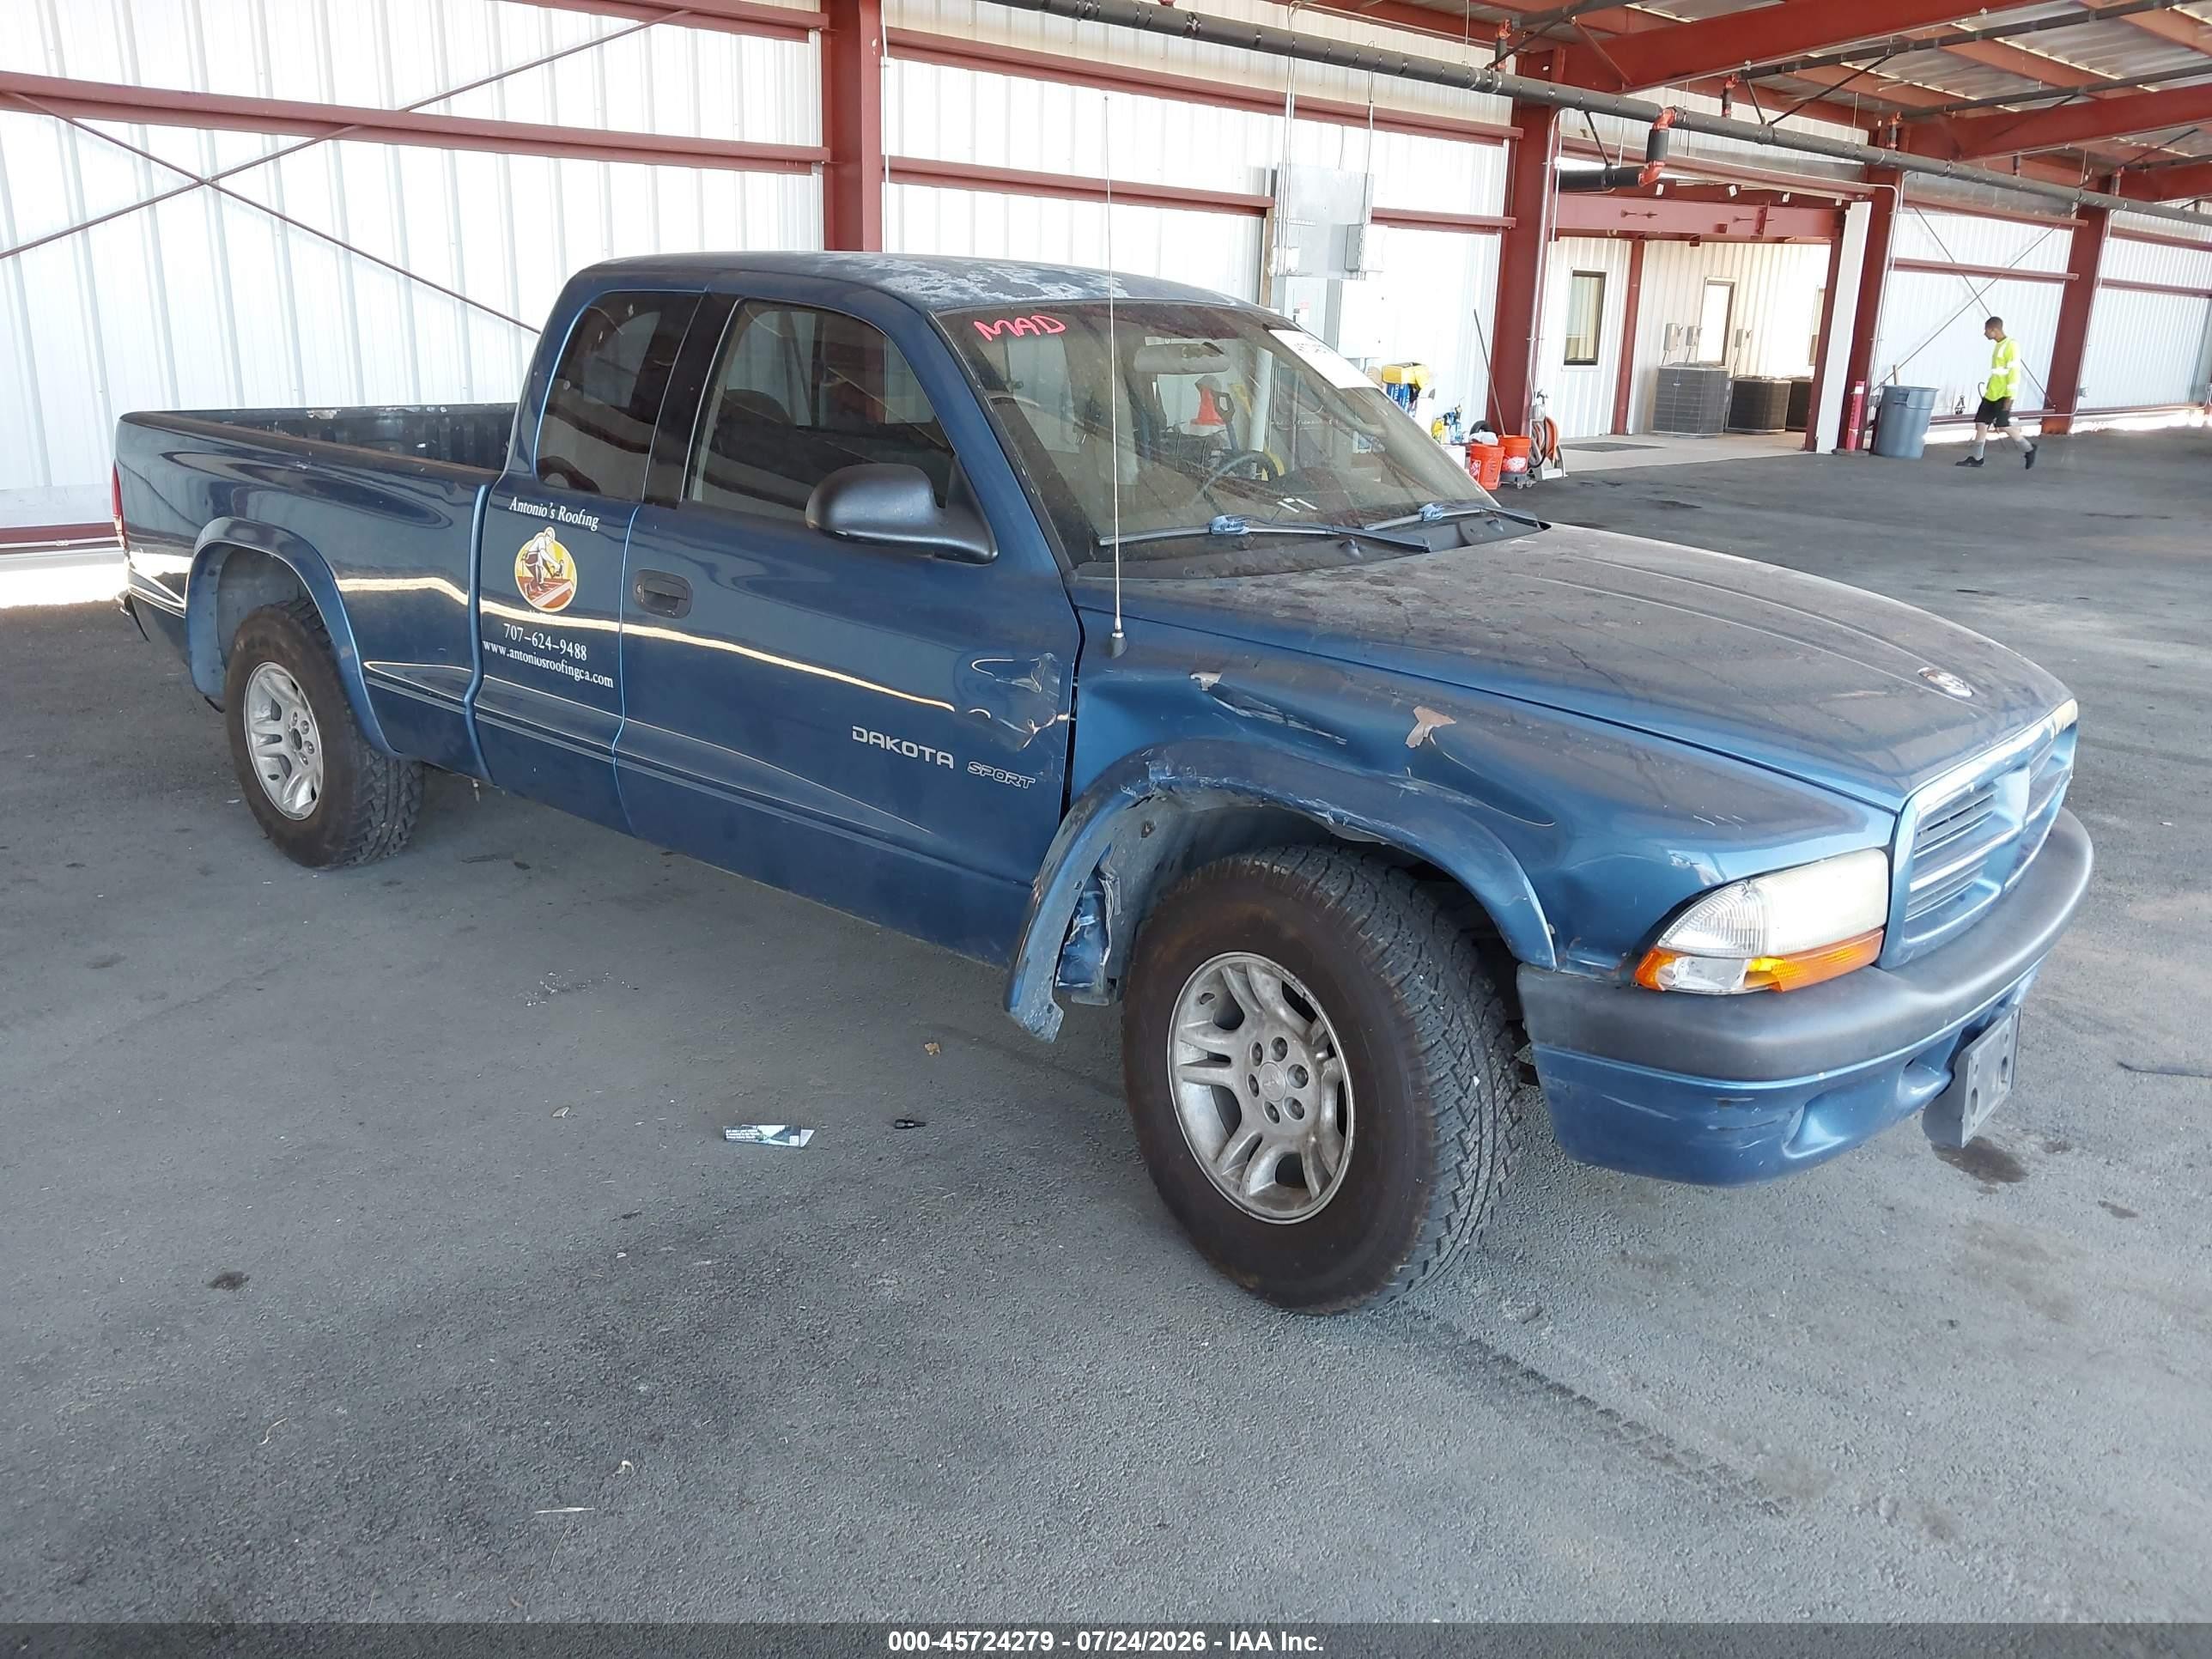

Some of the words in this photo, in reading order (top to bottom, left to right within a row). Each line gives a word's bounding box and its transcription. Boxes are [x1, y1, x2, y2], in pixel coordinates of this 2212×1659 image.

[973, 314, 1066, 342] MAD
[508, 495, 556, 520] Antonio's
[557, 505, 600, 532] Roofing
[503, 623, 588, 661] 707-624-9488
[483, 641, 614, 689] www.antoniosroofingca.com
[851, 725, 955, 769] DAKOTA
[967, 761, 1036, 789] SPORT
